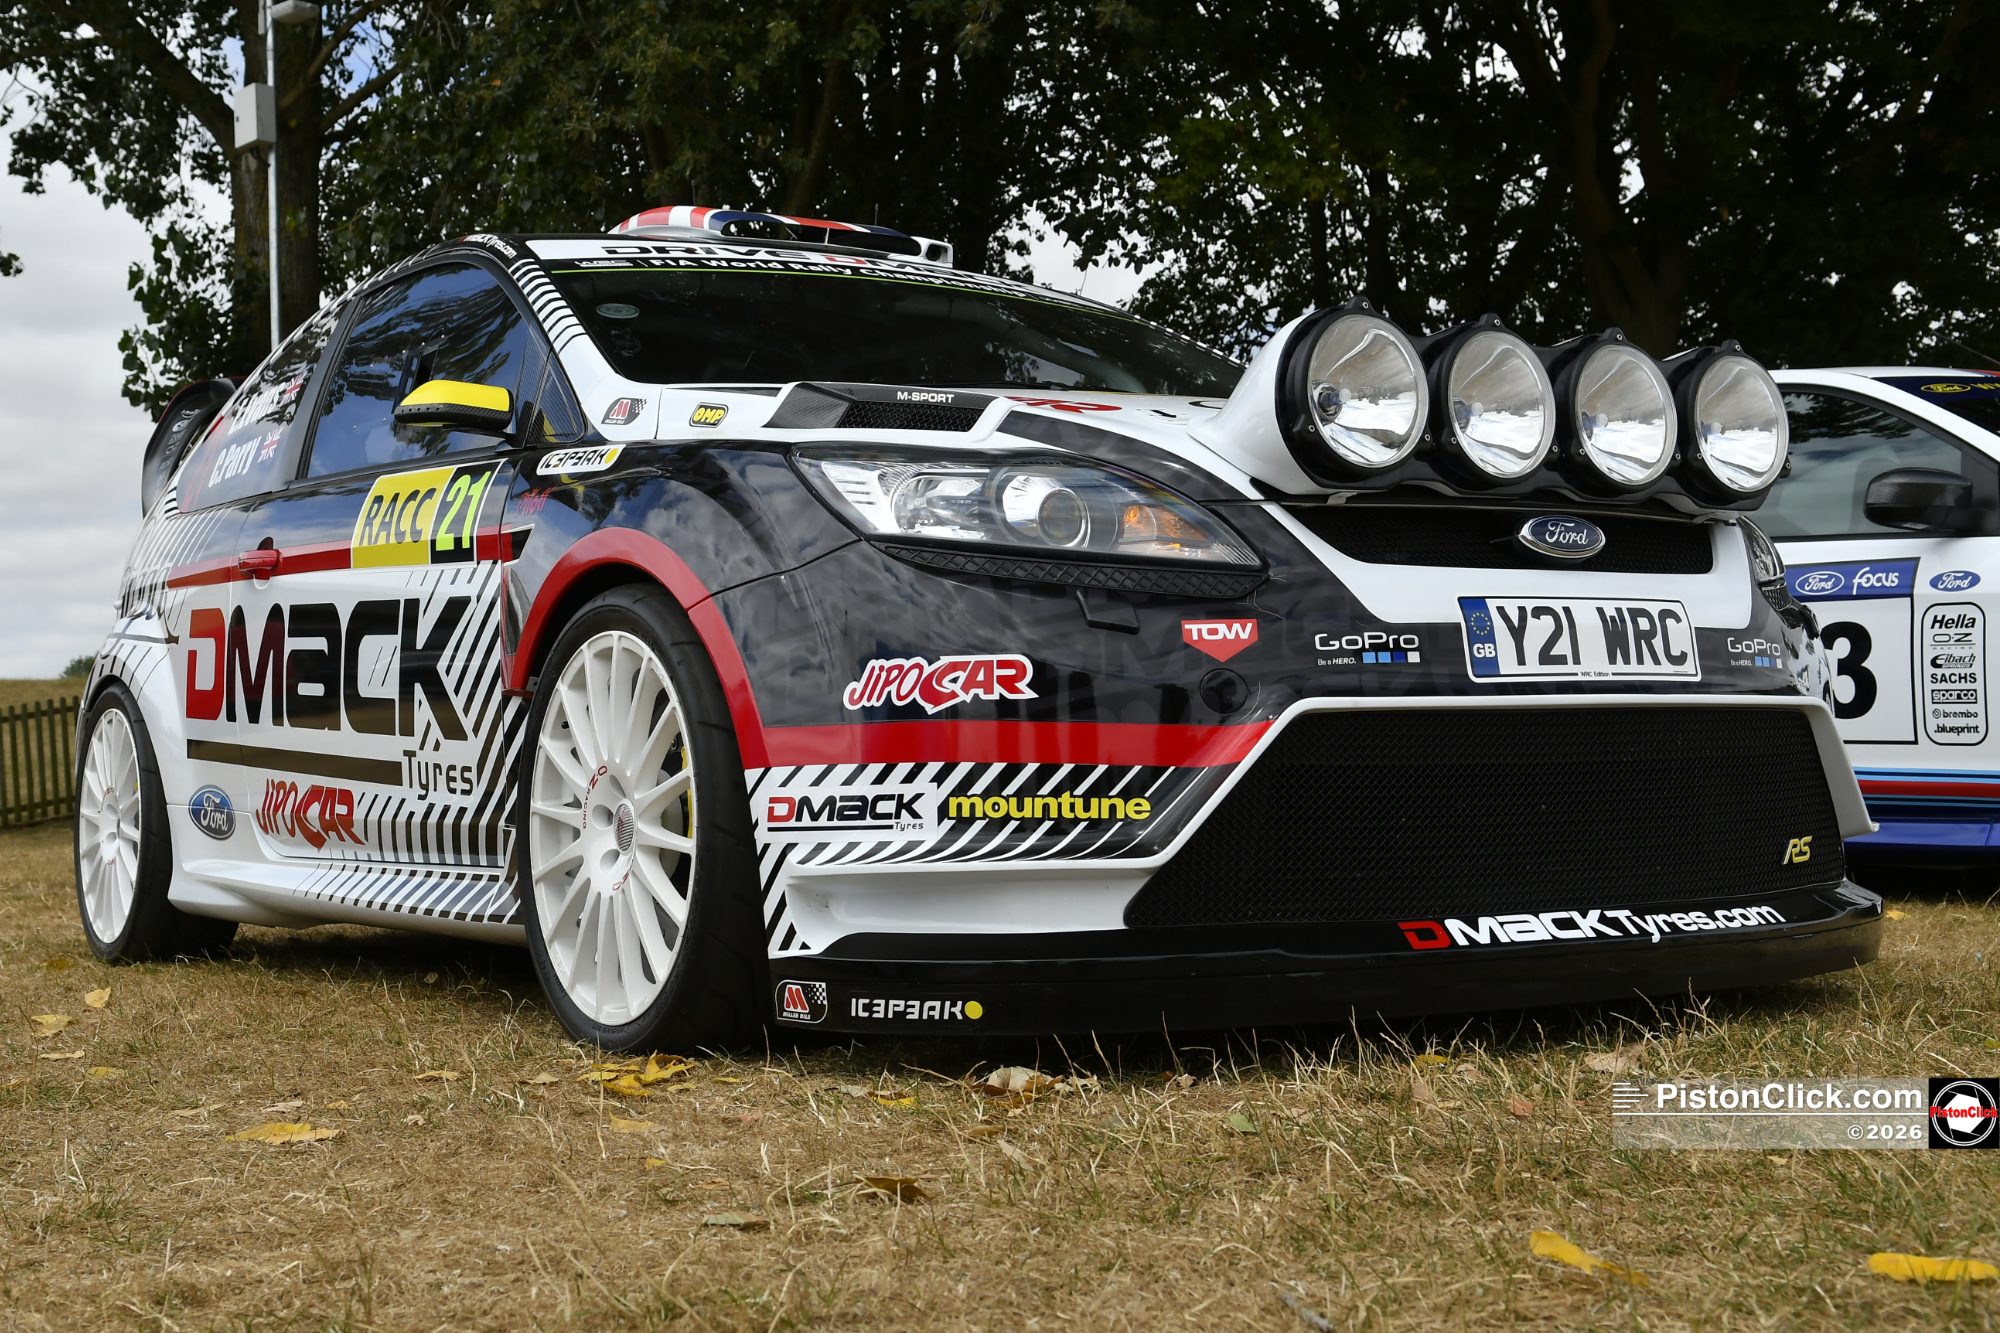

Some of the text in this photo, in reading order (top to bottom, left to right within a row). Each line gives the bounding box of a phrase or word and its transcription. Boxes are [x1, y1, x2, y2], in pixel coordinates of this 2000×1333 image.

[601, 246, 811, 260] DRIVE
[649, 259, 699, 267] FIA
[701, 259, 785, 270] World
[790, 263, 853, 276] Rally
[859, 268, 1027, 298] Championship
[896, 390, 955, 404] M-SPORT
[692, 407, 726, 424] OMP
[358, 470, 492, 552] RACC 21
[1545, 520, 1589, 545] Ford
[1804, 566, 1899, 596] Ford focus
[1937, 572, 1972, 590] Ford
[1930, 613, 1977, 629] Hella
[1184, 623, 1253, 640] TOW
[1495, 605, 1689, 667] Y21 WRC
[1314, 631, 1420, 651] GoPro
[1727, 637, 1781, 656] GoPro
[1473, 643, 1496, 658] GB
[1930, 653, 1976, 669] Eibach
[1930, 672, 1978, 684] SACHS
[1932, 689, 1977, 703] sparco
[1942, 709, 1979, 719] brembo
[402, 749, 475, 801] Tyres
[200, 793, 229, 832] Ford
[948, 790, 1152, 820] mountune
[895, 821, 924, 832] Tyres
[1782, 835, 1813, 865] RS
[782, 1011, 799, 1019] MILLER
